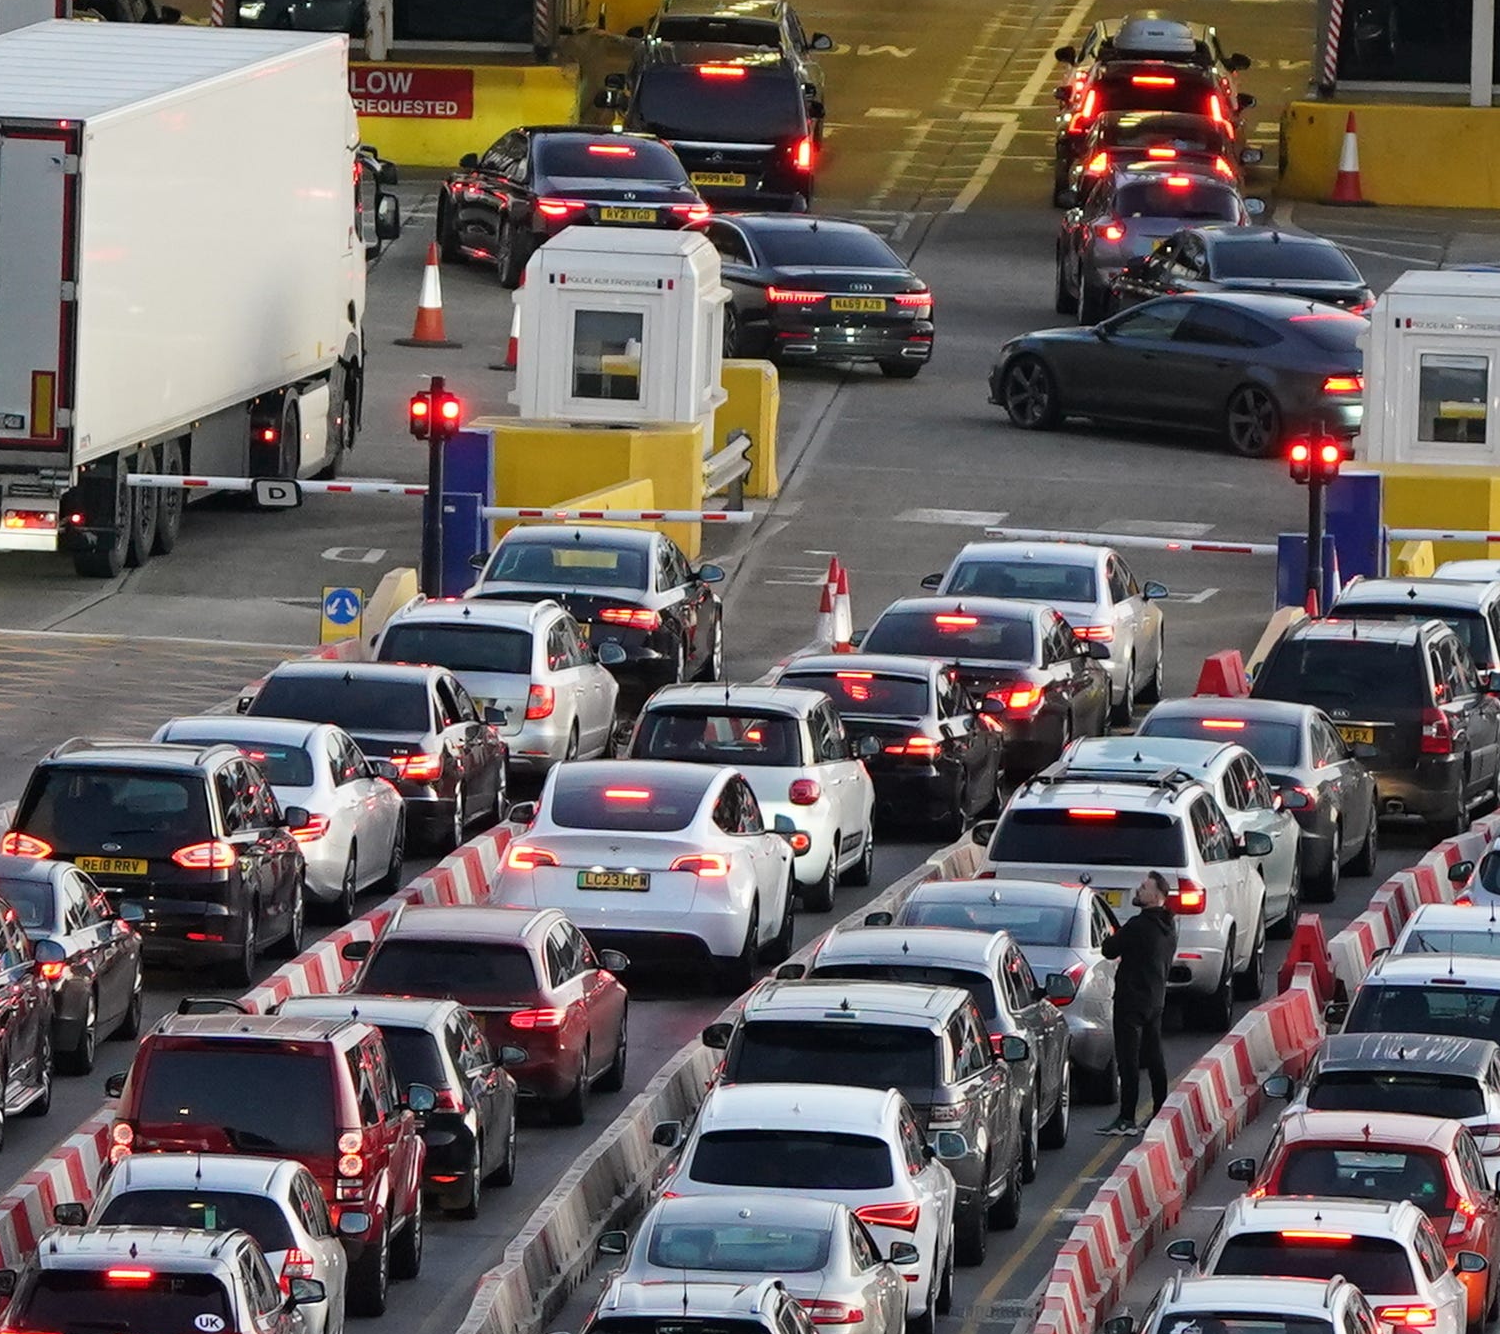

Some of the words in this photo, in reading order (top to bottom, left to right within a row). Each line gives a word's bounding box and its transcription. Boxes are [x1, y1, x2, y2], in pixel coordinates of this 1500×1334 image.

[350, 72, 413, 94] LOW
[269, 487, 287, 500] D
[83, 859, 110, 871] RE18
[114, 860, 138, 872] RRV
[585, 871, 618, 884] LC23
[199, 1318, 218, 1330] UK
